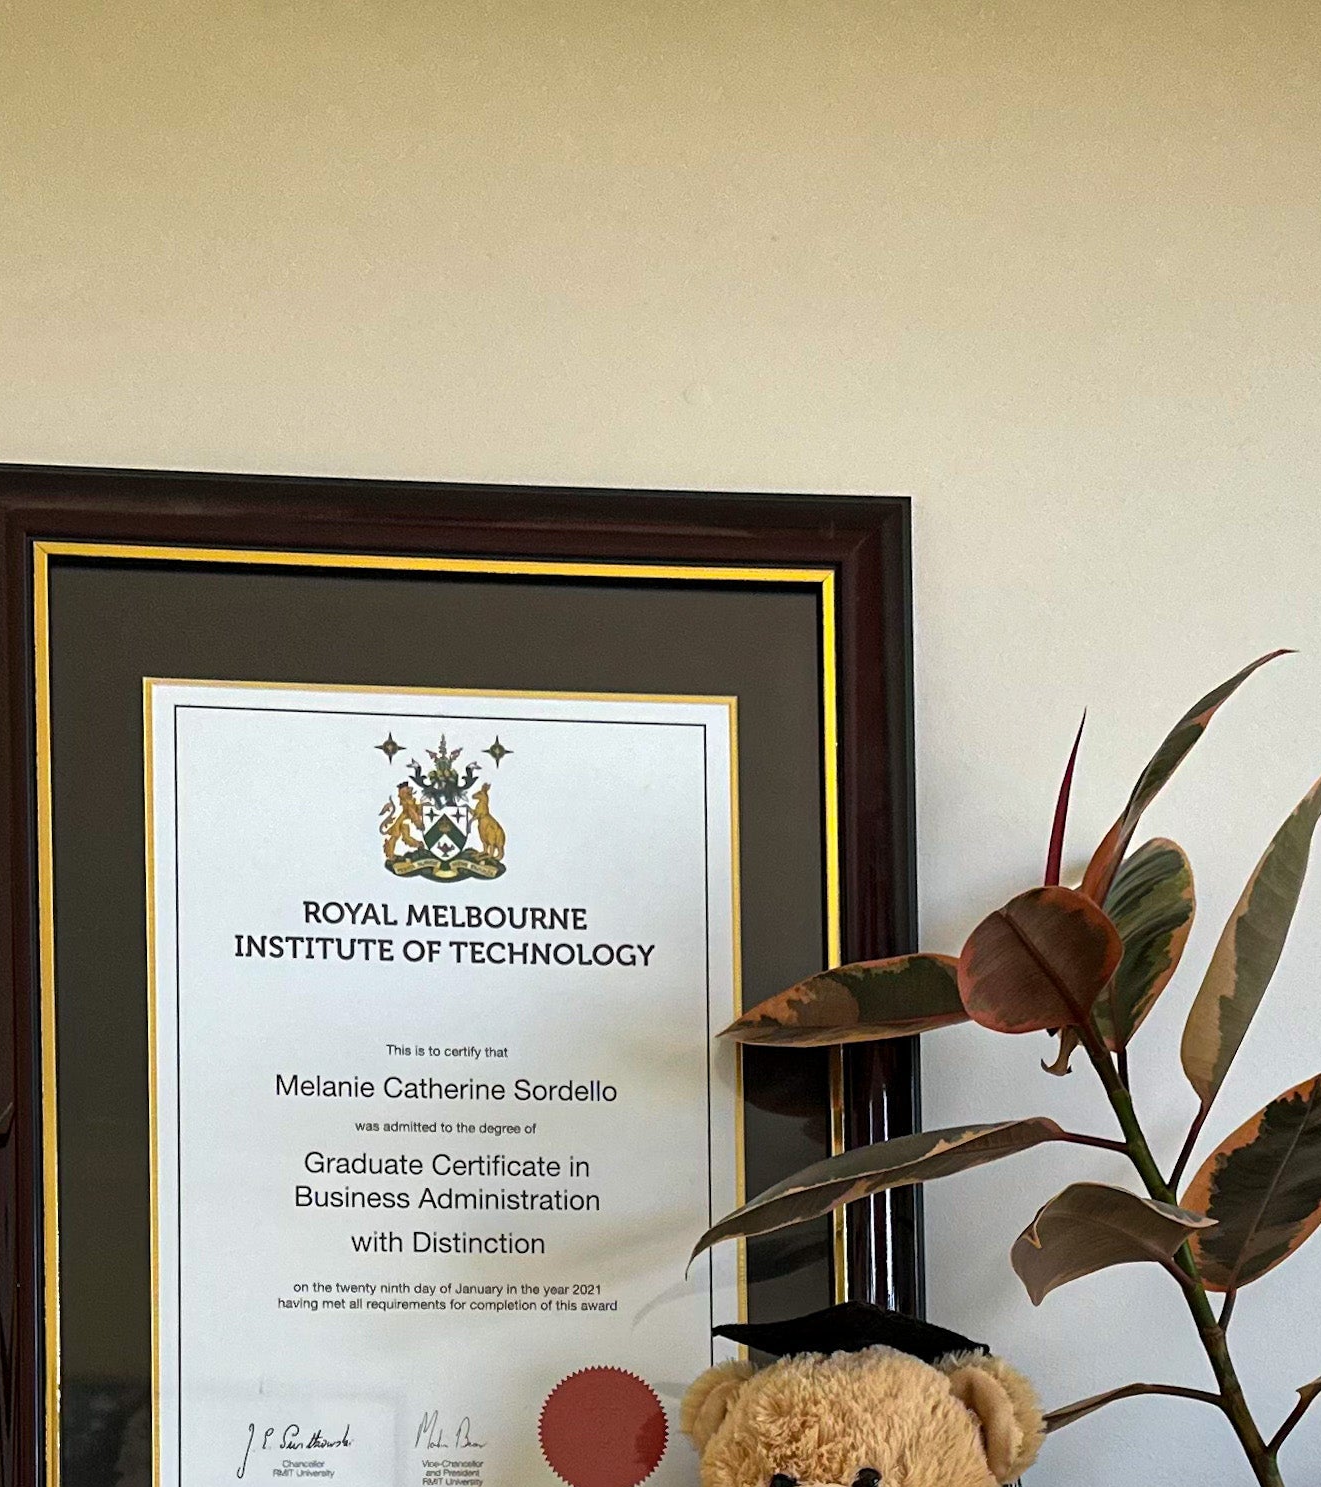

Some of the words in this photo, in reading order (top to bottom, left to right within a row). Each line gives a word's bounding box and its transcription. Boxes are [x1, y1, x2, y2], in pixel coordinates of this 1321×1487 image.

[303, 901, 398, 926] ROYAL
[406, 904, 588, 931] MELBOURNE
[234, 934, 394, 962] INSTITUTE
[402, 939, 442, 964] OF
[449, 941, 655, 967] TECHNOLOGY
[385, 1044, 411, 1056] This
[415, 1045, 425, 1057] is
[428, 1046, 441, 1057] to
[444, 1045, 481, 1060] certify
[484, 1046, 509, 1059] that
[276, 1074, 375, 1098] Melanie
[383, 1076, 506, 1101] Catherine
[514, 1079, 618, 1103] Sordello
[355, 1122, 380, 1132] was
[383, 1121, 437, 1133] admitted
[440, 1122, 453, 1133] to
[456, 1122, 476, 1134] the
[478, 1122, 521, 1136] degree
[524, 1123, 537, 1135] of
[304, 1151, 424, 1176] Graduate
[431, 1153, 561, 1177] Certificate
[569, 1155, 590, 1178] in
[295, 1185, 410, 1209] Business
[418, 1187, 600, 1211] Administration
[351, 1231, 403, 1252] with
[413, 1231, 545, 1254] Distinction
[293, 1283, 309, 1293] on
[312, 1282, 333, 1293] the
[336, 1282, 377, 1296] twenty
[380, 1283, 410, 1294] ninth
[413, 1283, 437, 1297] day
[439, 1283, 452, 1294] of
[455, 1283, 503, 1298] January
[506, 1284, 518, 1295] in
[520, 1284, 540, 1295] the
[543, 1284, 570, 1298] year
[572, 1284, 602, 1295] 2021
[278, 1298, 318, 1311] having
[322, 1299, 346, 1310] met
[349, 1299, 363, 1310] all
[366, 1299, 447, 1312] requirements
[449, 1299, 466, 1310] for
[469, 1300, 537, 1312] completion
[540, 1300, 553, 1311] of
[556, 1300, 578, 1311] this
[580, 1300, 618, 1311] award
[282, 1460, 326, 1469] Chancellor
[422, 1460, 484, 1468] Vice-Chancellor
[273, 1469, 294, 1477] RMIT
[297, 1469, 335, 1479] University
[425, 1469, 441, 1477] and
[443, 1468, 480, 1477] President
